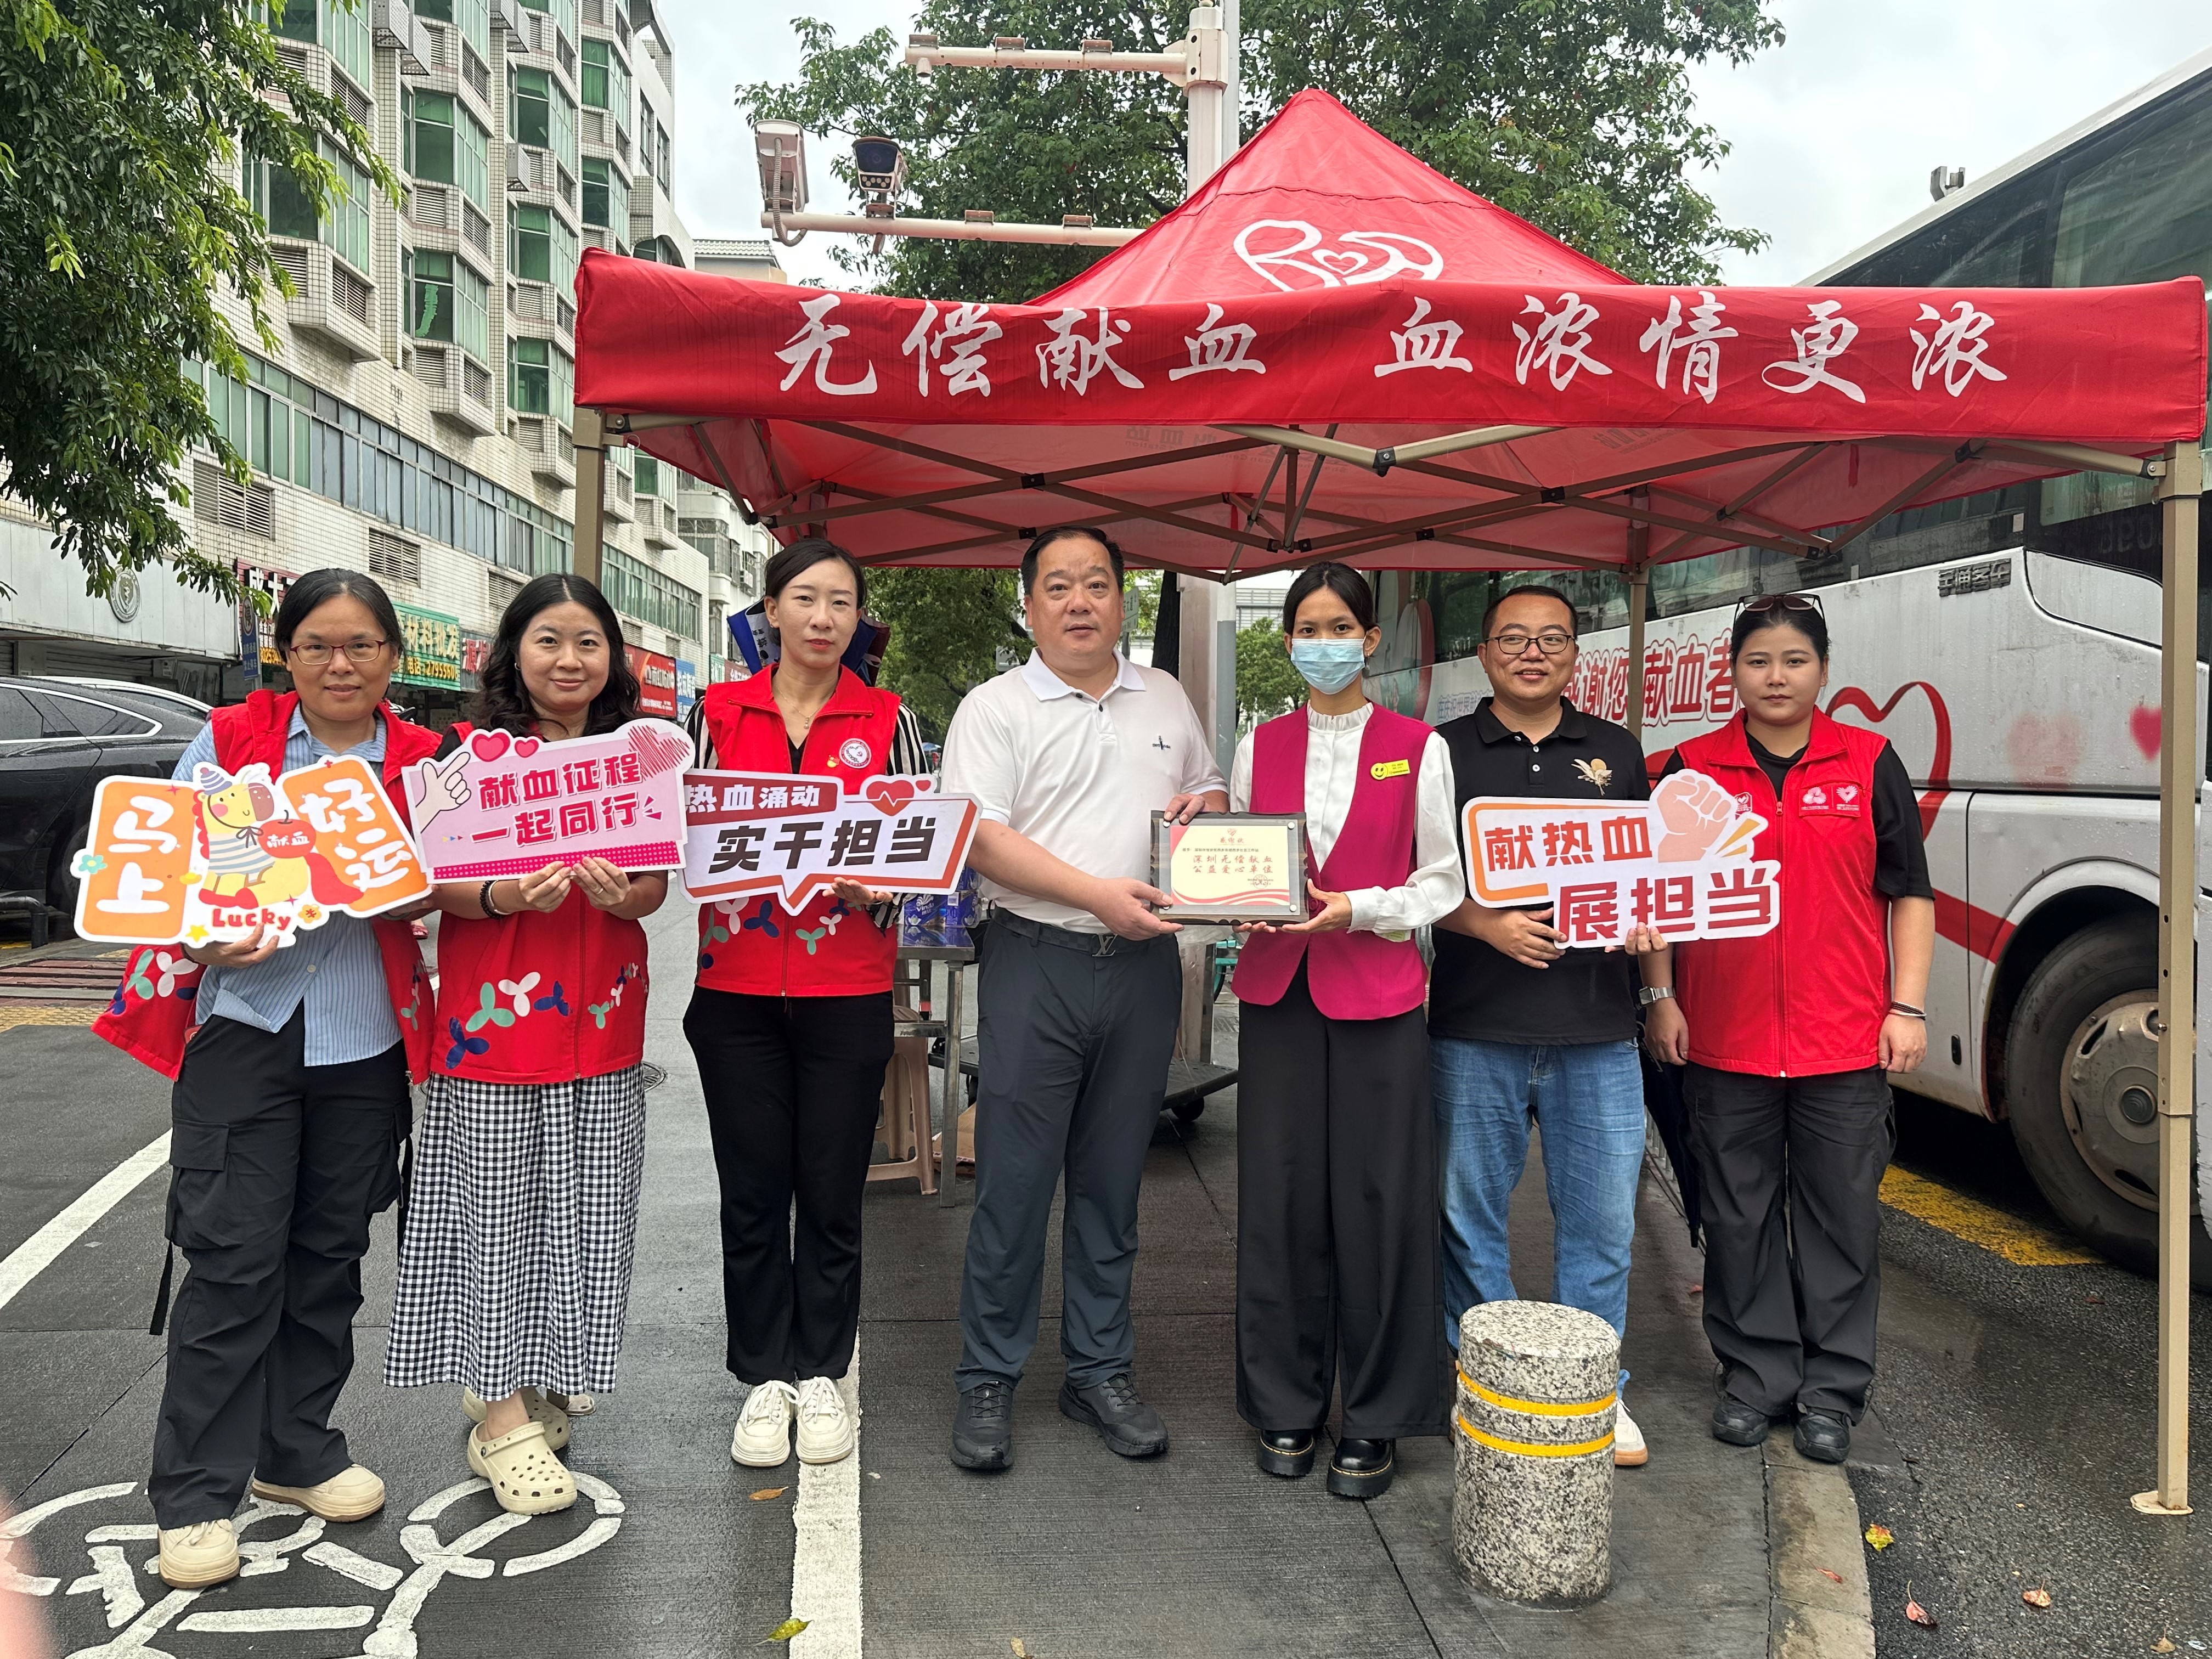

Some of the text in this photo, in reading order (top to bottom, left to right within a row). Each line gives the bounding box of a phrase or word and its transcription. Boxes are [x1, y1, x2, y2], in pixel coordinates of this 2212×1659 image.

[775, 290, 2008, 405] 无偿献血 血浓情更浓
[249, 567, 295, 614] 成大
[396, 611, 458, 660] 材料批发
[1438, 693, 1482, 720] 在庆祝世界献
[478, 752, 642, 811] 献血征程
[685, 783, 820, 813] 热血涌动
[267, 831, 311, 848] 献血
[298, 778, 412, 892] 好运
[470, 791, 640, 848] 一起同行
[709, 816, 936, 874] 实干担当
[1484, 816, 1653, 872] 献热血
[97, 795, 177, 913] 马上
[1193, 854, 1273, 864] 深圳无偿献血
[1193, 864, 1273, 874] 公益爱心单位
[212, 908, 291, 931] Lucky
[1559, 867, 1771, 943] 展担当
